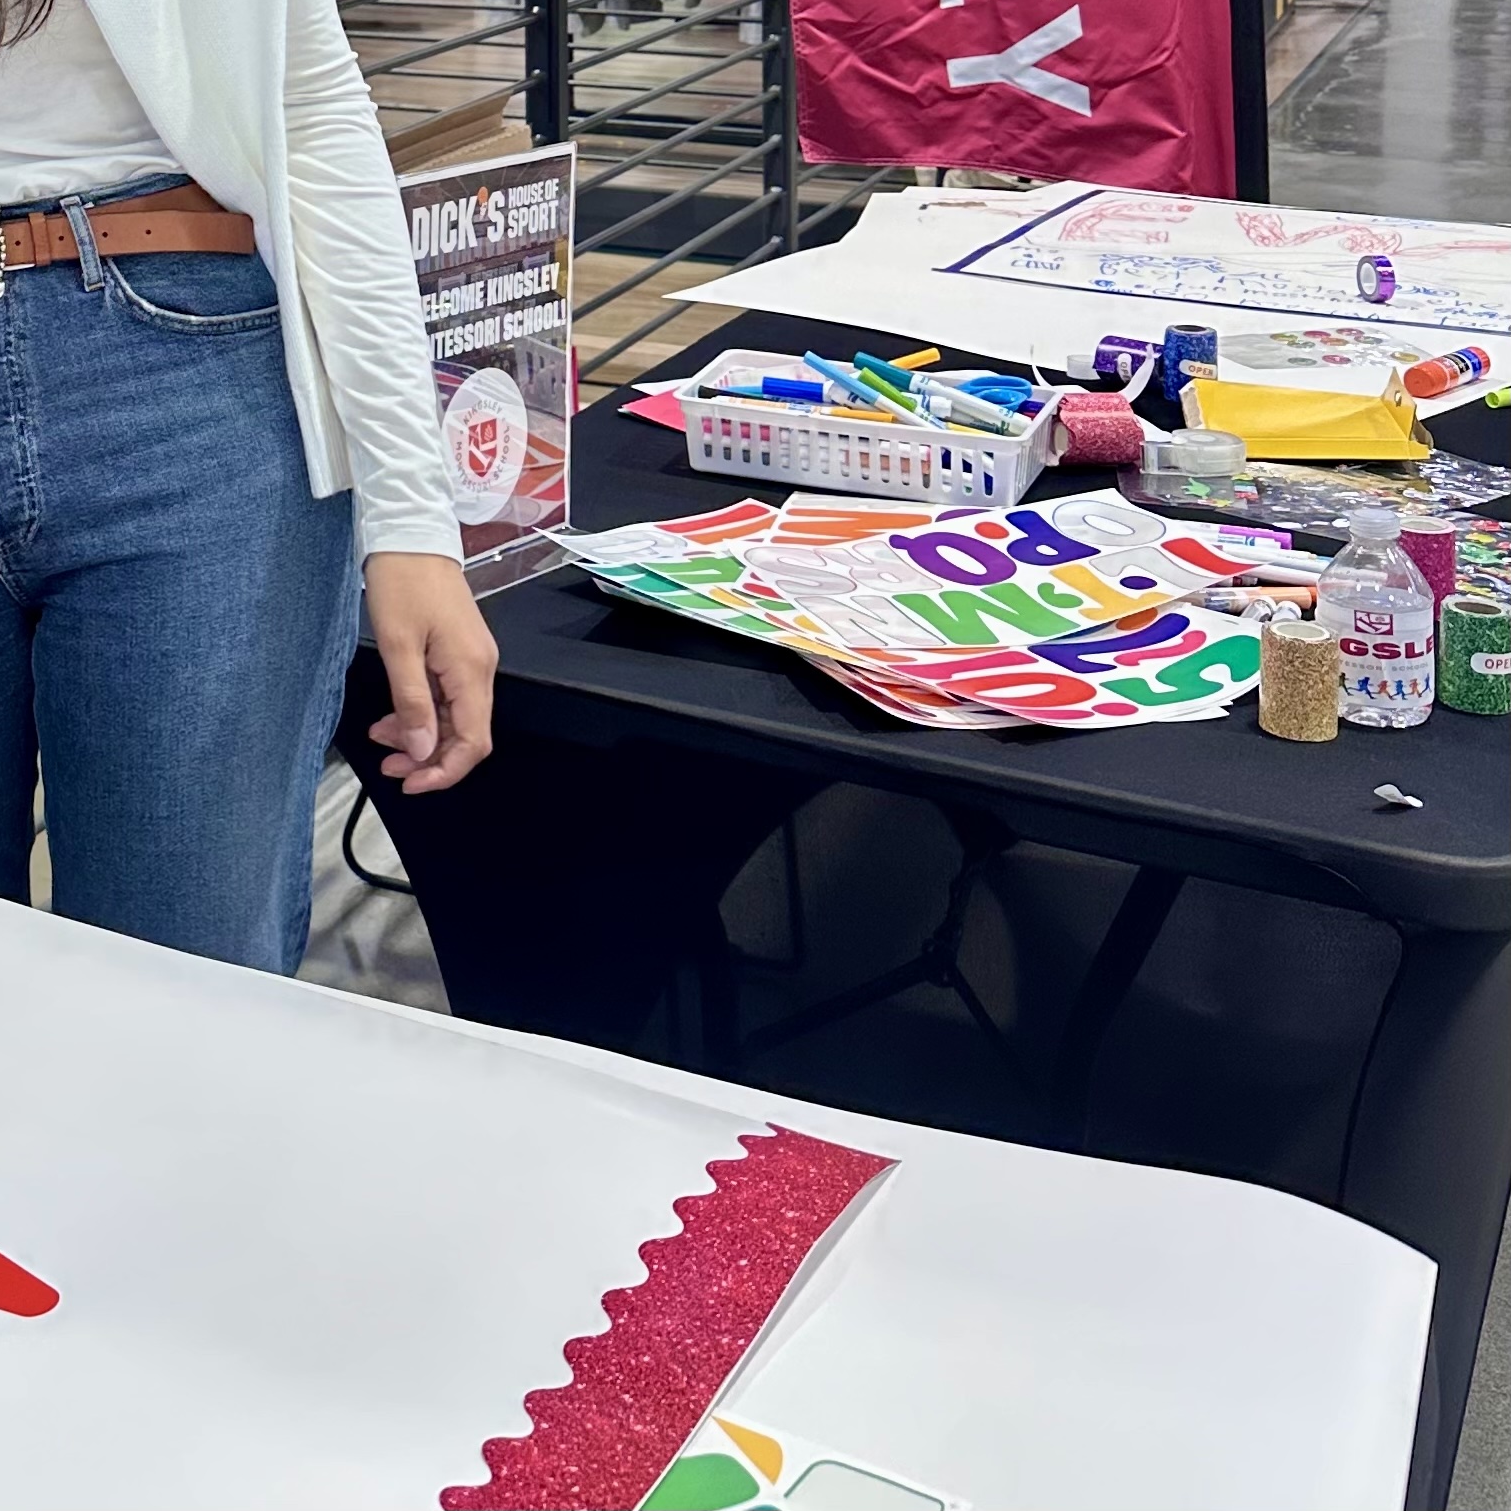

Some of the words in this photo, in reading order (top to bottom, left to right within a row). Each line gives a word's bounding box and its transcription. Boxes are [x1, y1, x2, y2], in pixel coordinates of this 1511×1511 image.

[508, 181, 544, 208] HOUSE
[544, 178, 559, 200] OF
[412, 187, 505, 261] DICK'S
[507, 200, 559, 238] SPORT
[487, 262, 560, 307] KINGSLEY
[502, 298, 567, 341] SCHOOL!
[1188, 364, 1214, 377] OPEN
[1484, 658, 1511, 670] OPE
